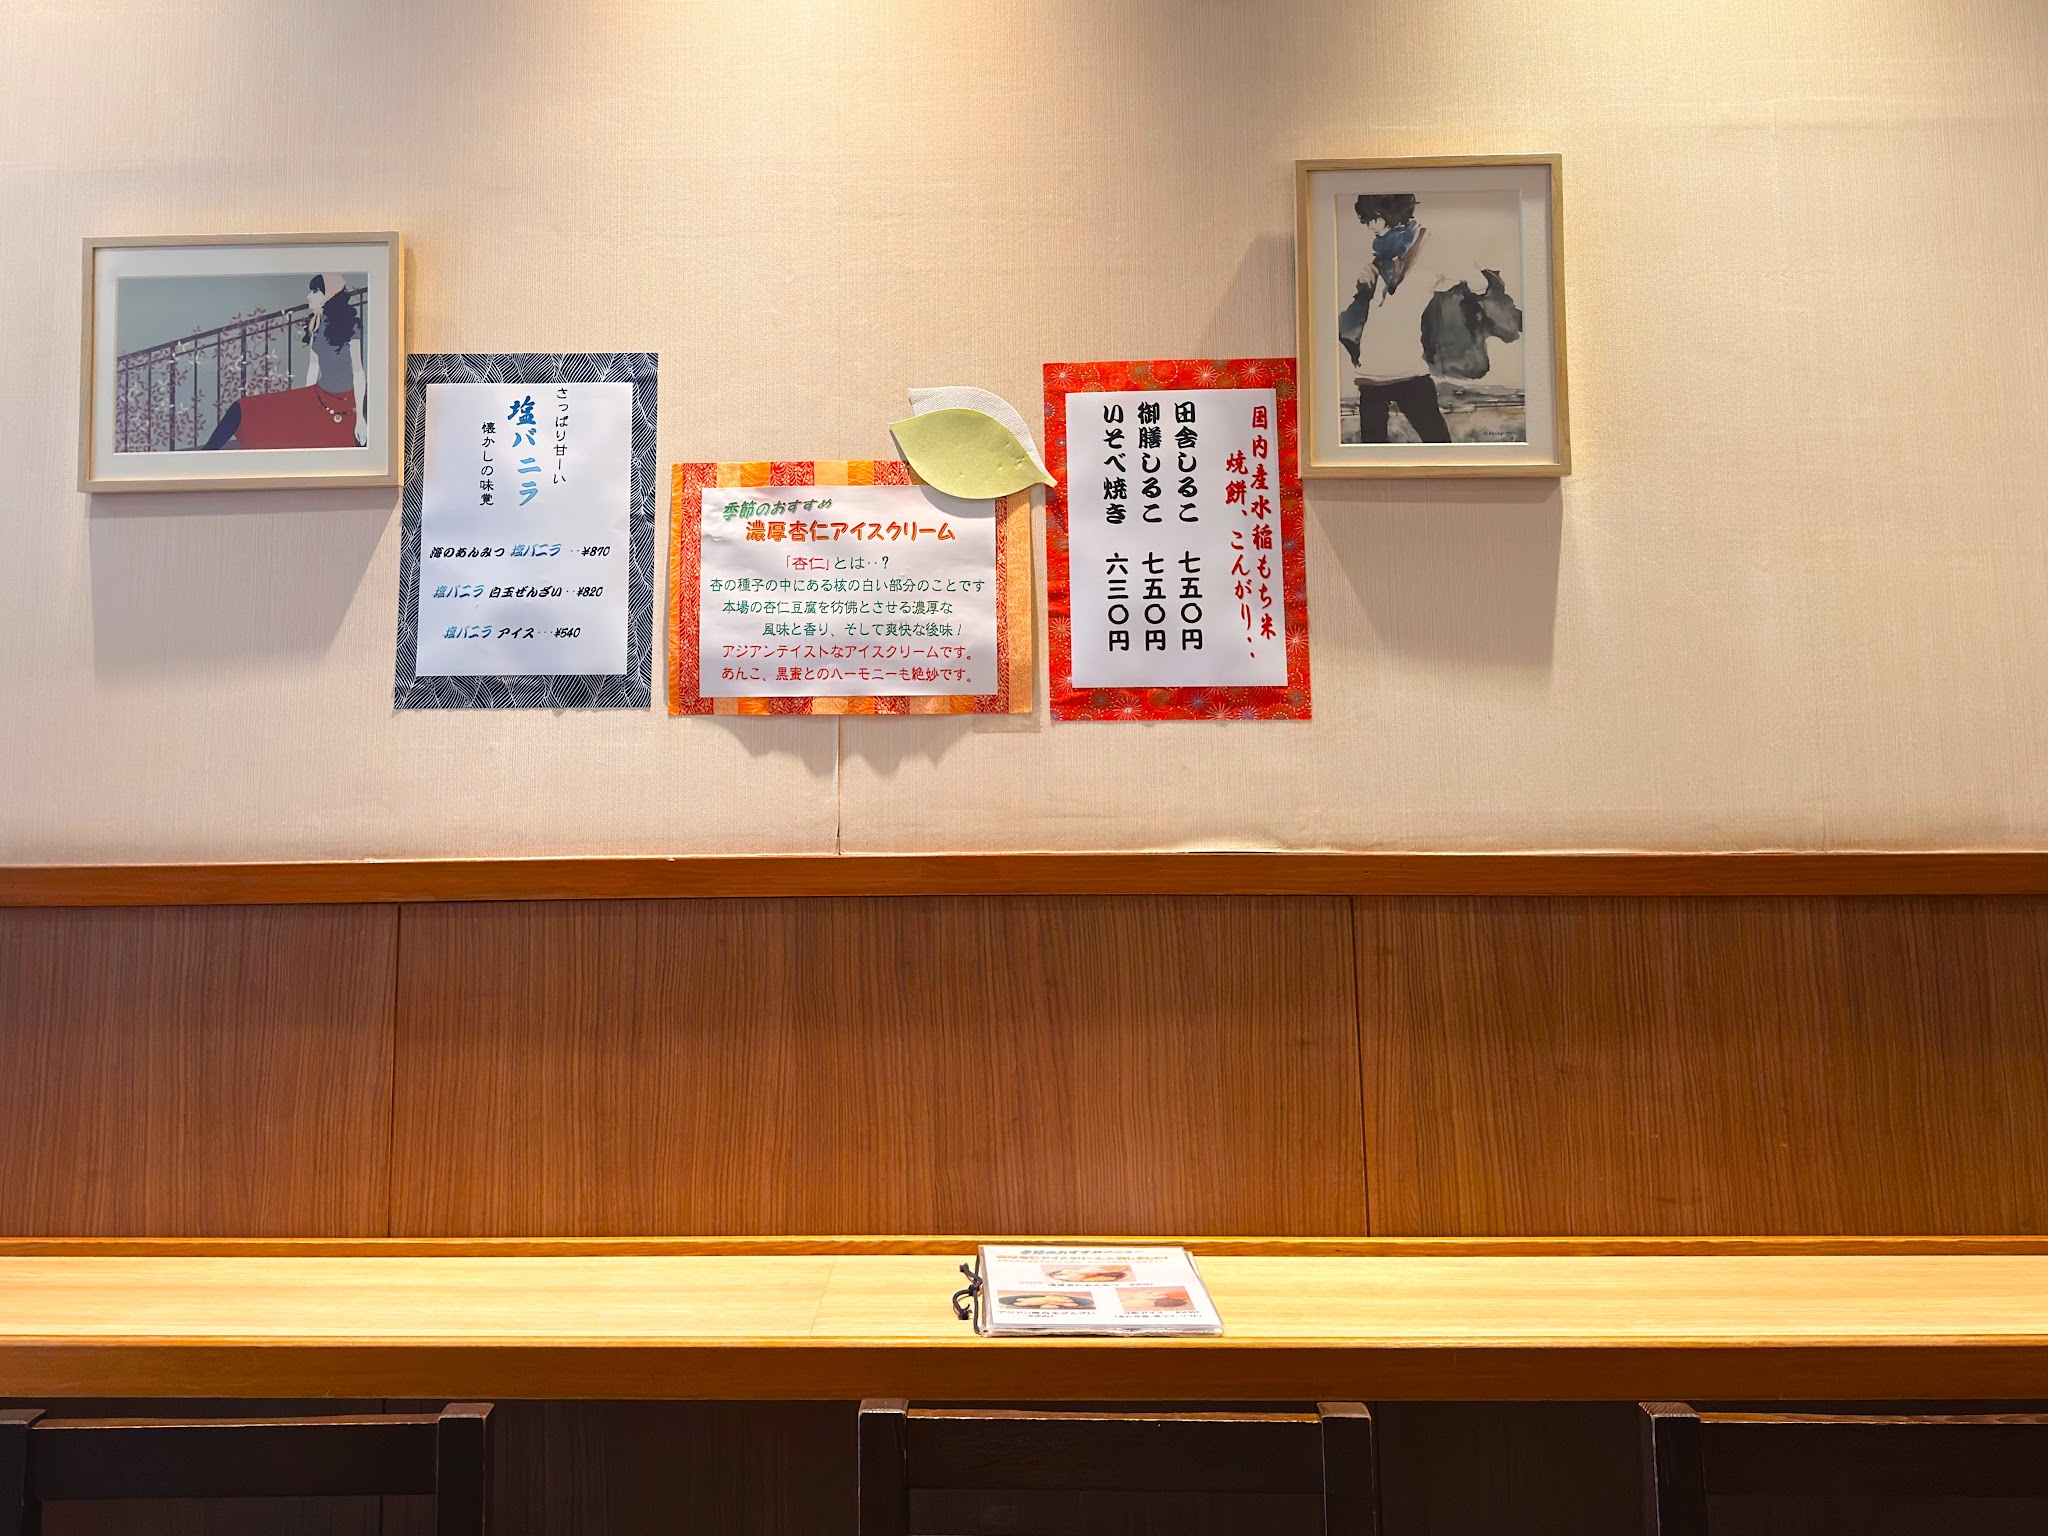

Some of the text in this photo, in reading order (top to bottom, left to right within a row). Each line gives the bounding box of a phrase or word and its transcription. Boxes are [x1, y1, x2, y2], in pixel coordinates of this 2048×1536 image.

[507, 395, 542, 507] 塩バニラ
[553, 387, 570, 484] さっぱり甘ーい
[1137, 401, 1163, 523] 御膳しるこ
[1174, 401, 1199, 523] 田舎しるこ
[479, 421, 497, 507] 懐かしの味覚
[1103, 403, 1129, 525] いそべ焼き
[722, 498, 833, 521] 季節のおすすめ
[745, 520, 956, 543] 濃厚杏仁アイスクリーム
[1251, 405, 1277, 641] 国内産水稲もち米
[510, 543, 562, 558] 塩バニラ
[433, 585, 485, 599] 塩バニラ
[488, 585, 563, 599] 白玉ぜんざい
[709, 577, 986, 594] 杏の種子の中にある核の白い部分のことです
[444, 625, 493, 640] 塩バニラ
[497, 626, 535, 640] アイス
[722, 644, 972, 661] アジアンテイストなアイスクリームです。
